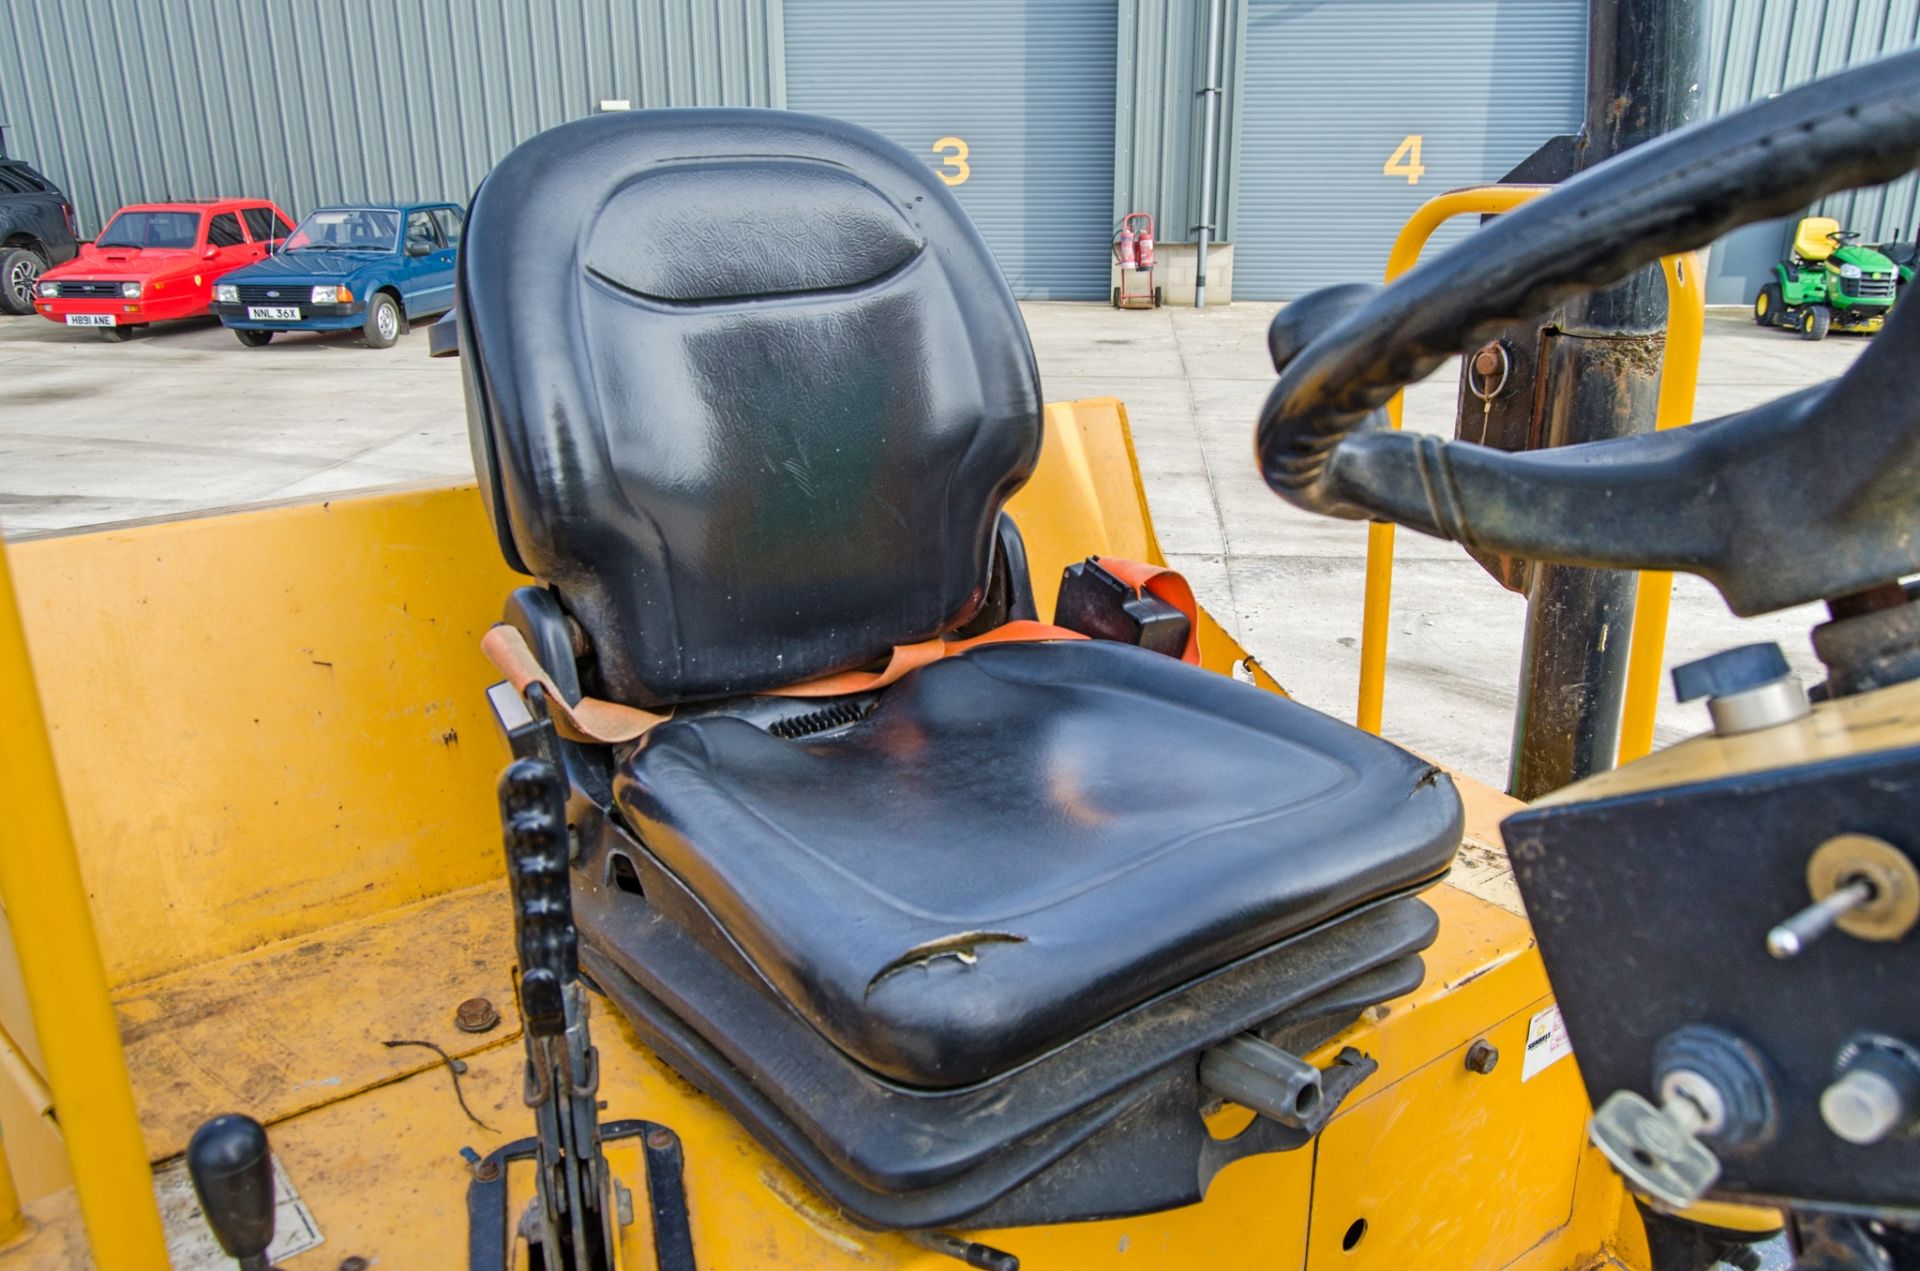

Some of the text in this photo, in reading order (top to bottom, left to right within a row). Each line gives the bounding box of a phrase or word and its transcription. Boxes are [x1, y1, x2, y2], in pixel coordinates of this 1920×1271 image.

[932, 136, 970, 186] 3
[1383, 134, 1425, 185] 4
[94, 315, 111, 325] ANE
[253, 308, 296, 319] NNL 36X
